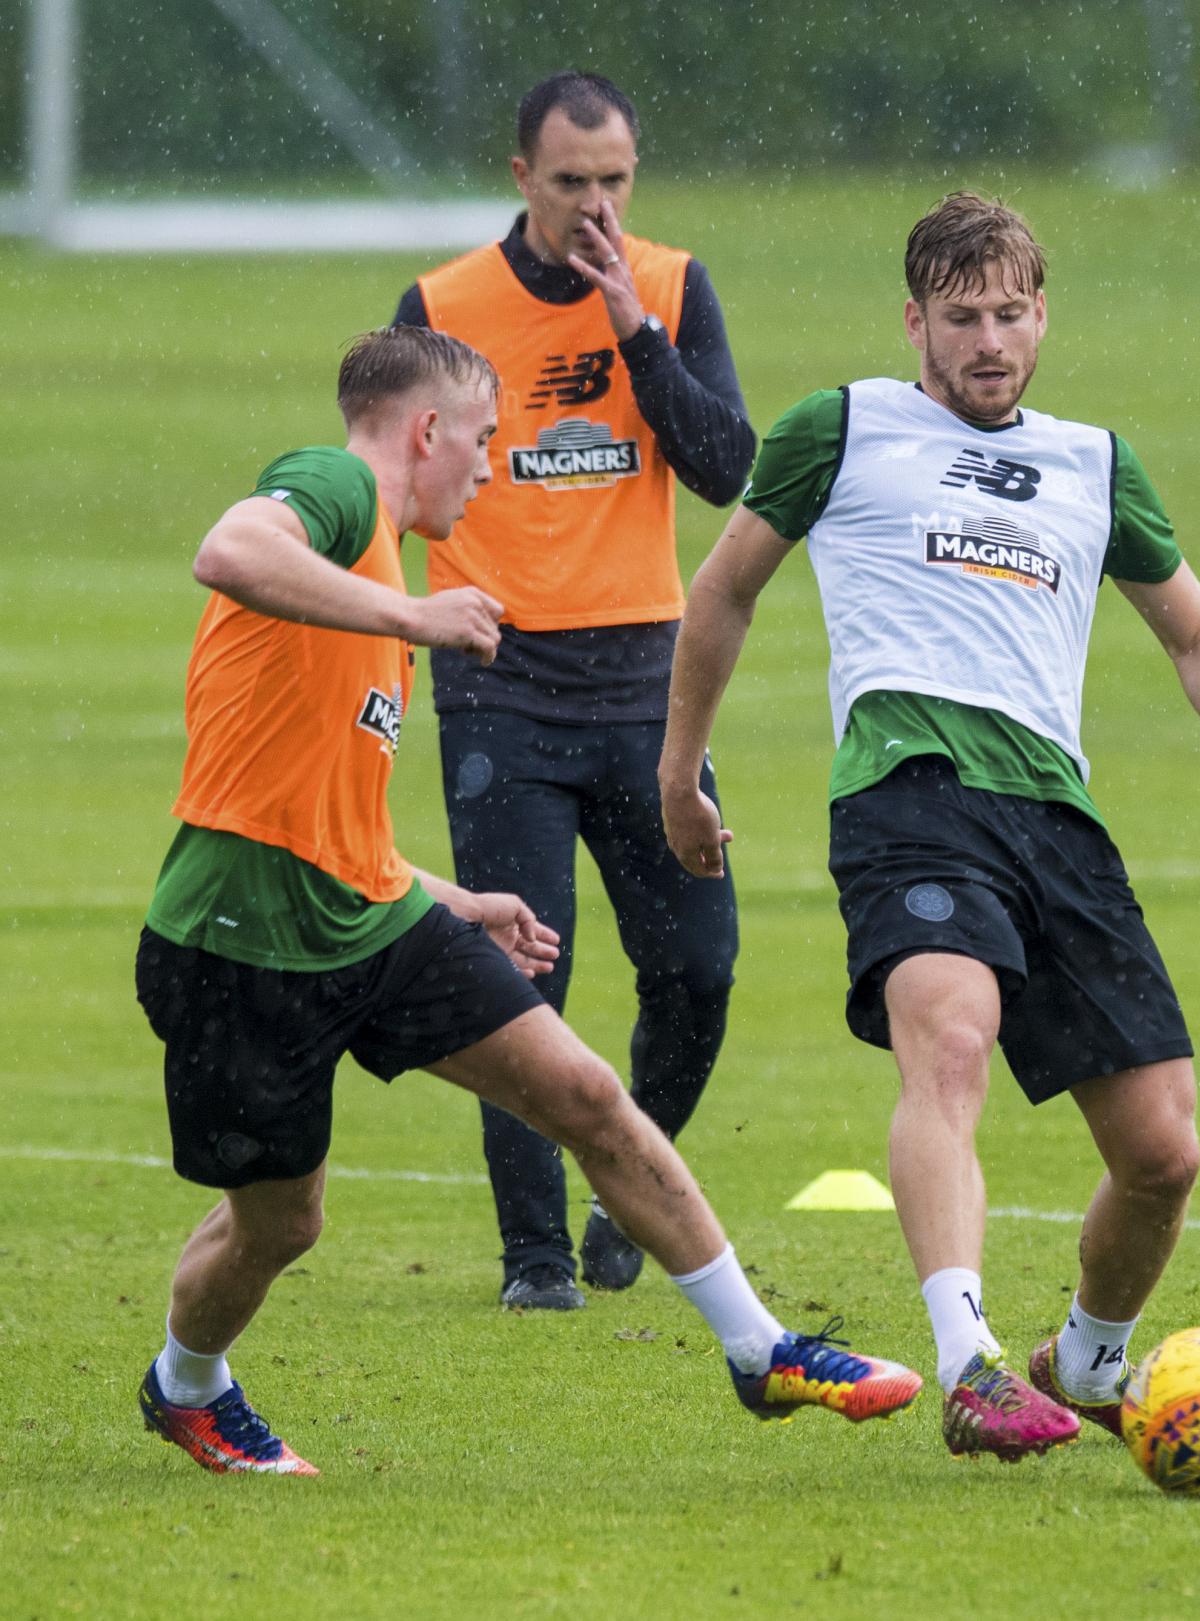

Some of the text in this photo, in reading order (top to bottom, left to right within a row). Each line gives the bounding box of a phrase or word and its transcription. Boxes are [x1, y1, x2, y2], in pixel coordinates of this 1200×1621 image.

[519, 446, 631, 475] MAGNERS
[935, 535, 1056, 584] MAGNERS
[969, 565, 1031, 586] IRISH CIDER
[1089, 1344, 1125, 1371] 14
